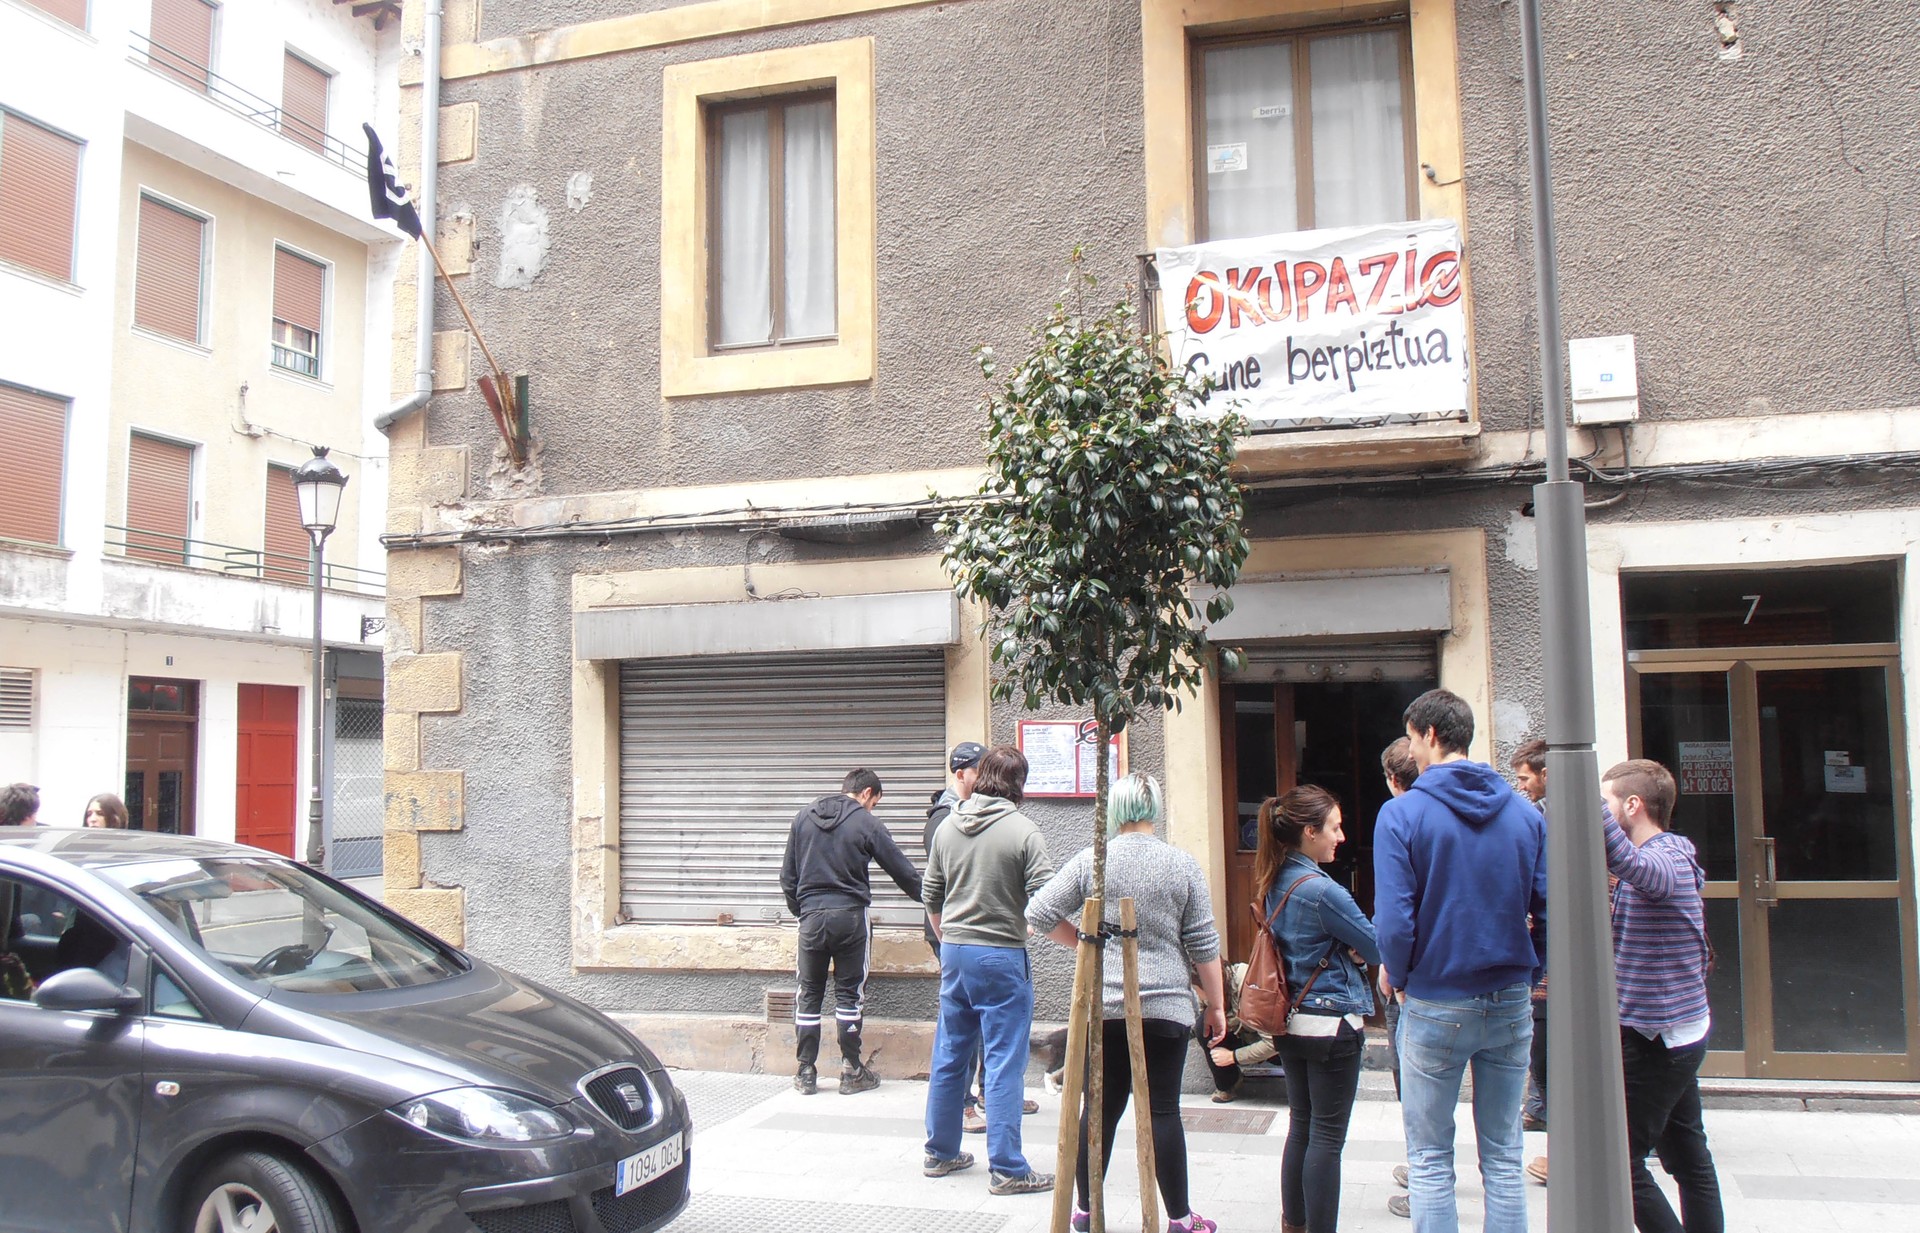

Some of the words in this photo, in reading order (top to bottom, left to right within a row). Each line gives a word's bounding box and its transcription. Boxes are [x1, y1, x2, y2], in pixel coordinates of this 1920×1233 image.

[1287, 321, 1452, 392] berpiztua
[1742, 595, 1761, 625] 7
[630, 1150, 657, 1186] 1094
